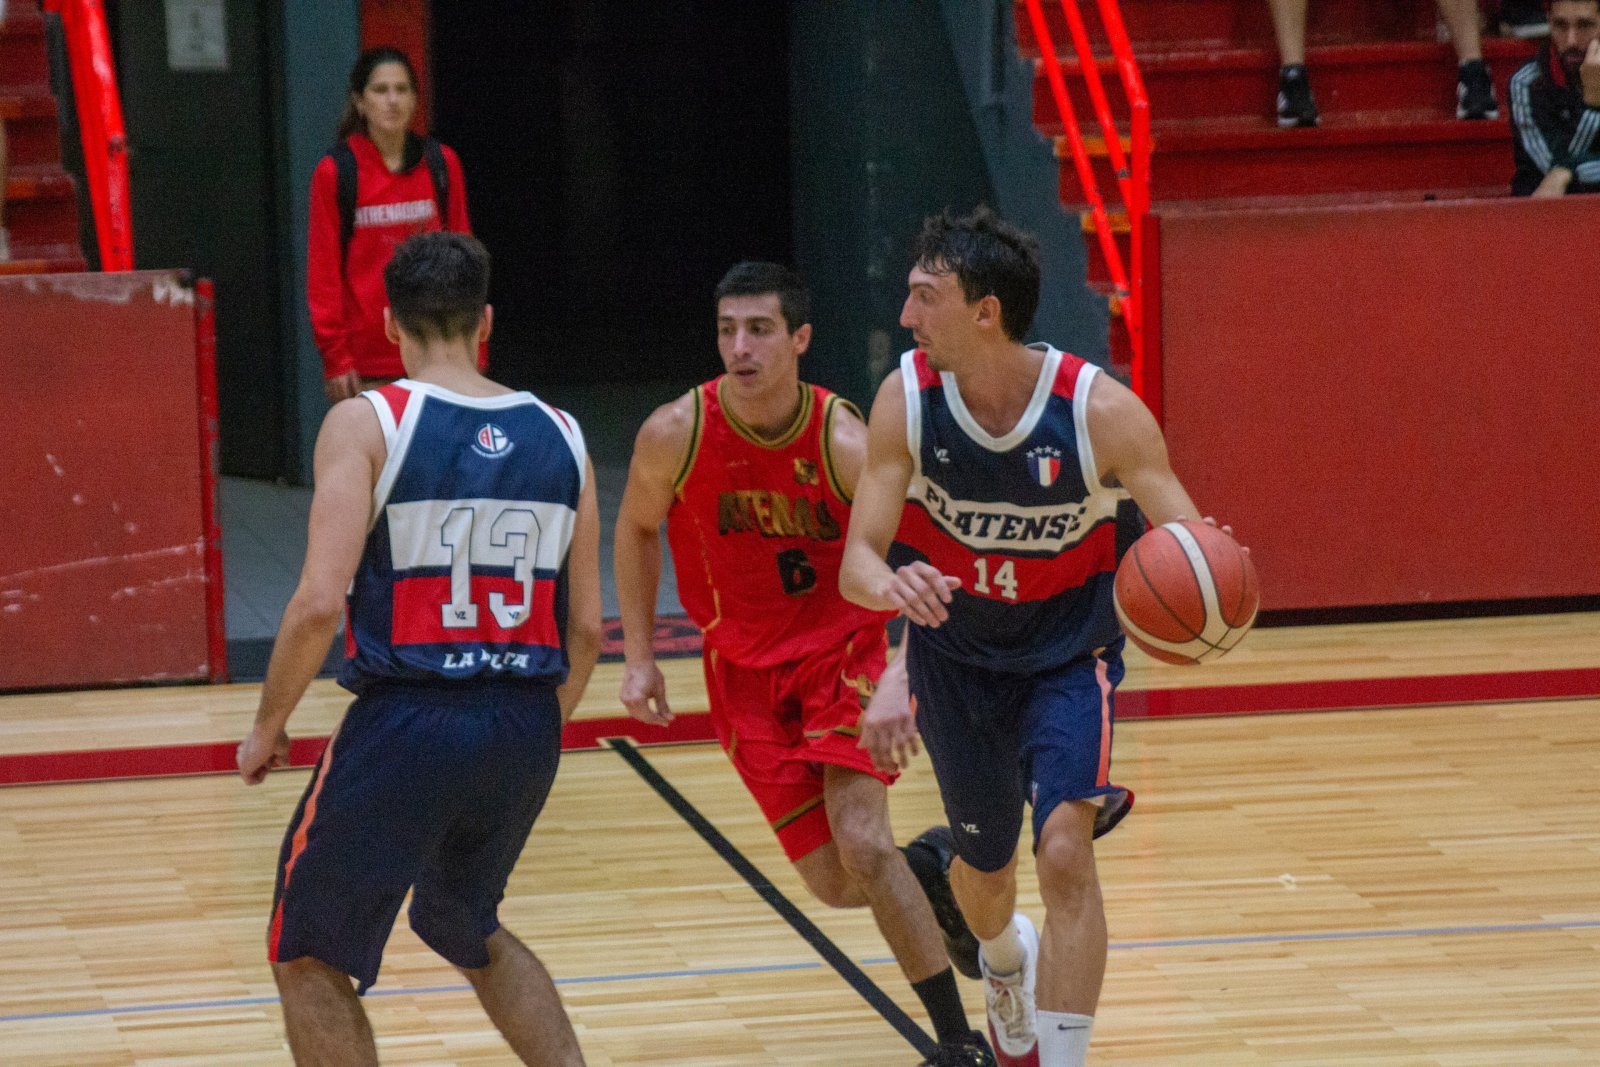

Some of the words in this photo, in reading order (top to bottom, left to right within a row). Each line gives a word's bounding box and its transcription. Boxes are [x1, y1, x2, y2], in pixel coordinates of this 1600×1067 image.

[441, 507, 541, 629] 13
[776, 548, 816, 596] 6
[973, 558, 1018, 600] 14
[442, 652, 474, 669] LA
